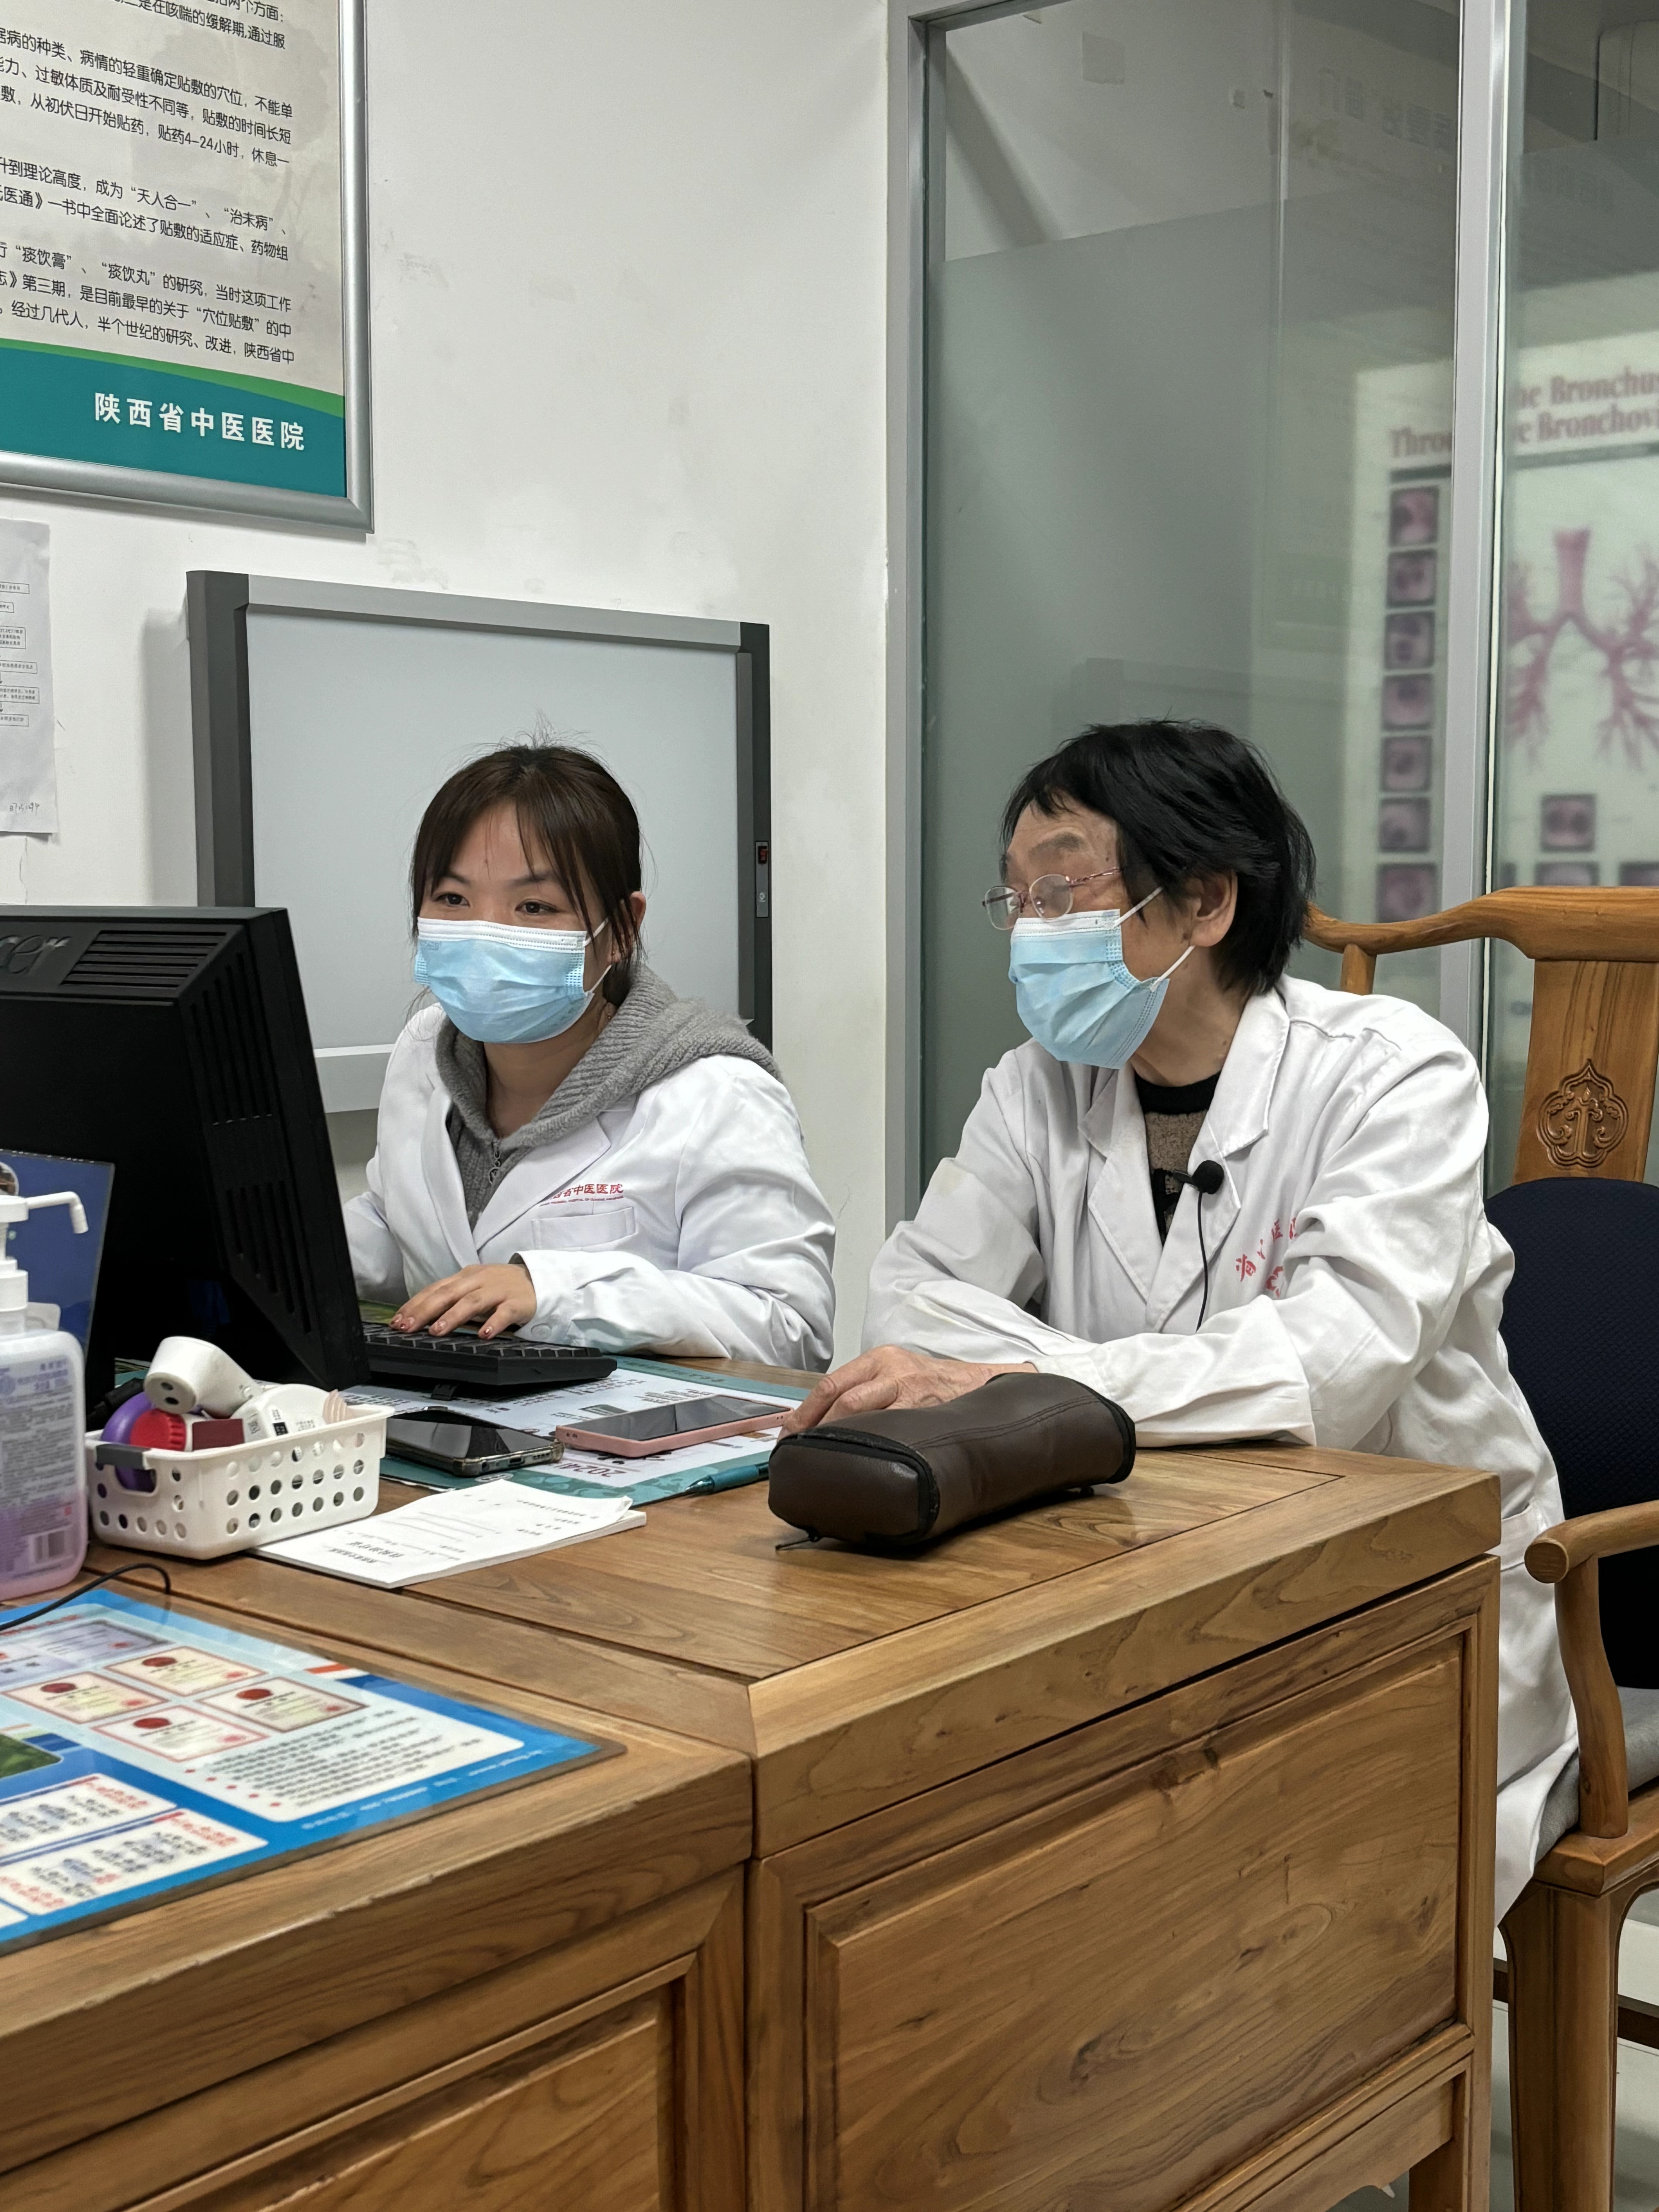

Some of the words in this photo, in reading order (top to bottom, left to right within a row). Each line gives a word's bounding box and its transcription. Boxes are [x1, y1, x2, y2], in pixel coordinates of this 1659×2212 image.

[0, 185, 289, 261] 医通》一书中全面论述了贴敷的适应症、药物组
[95, 392, 304, 450] 陕西省中医医院
